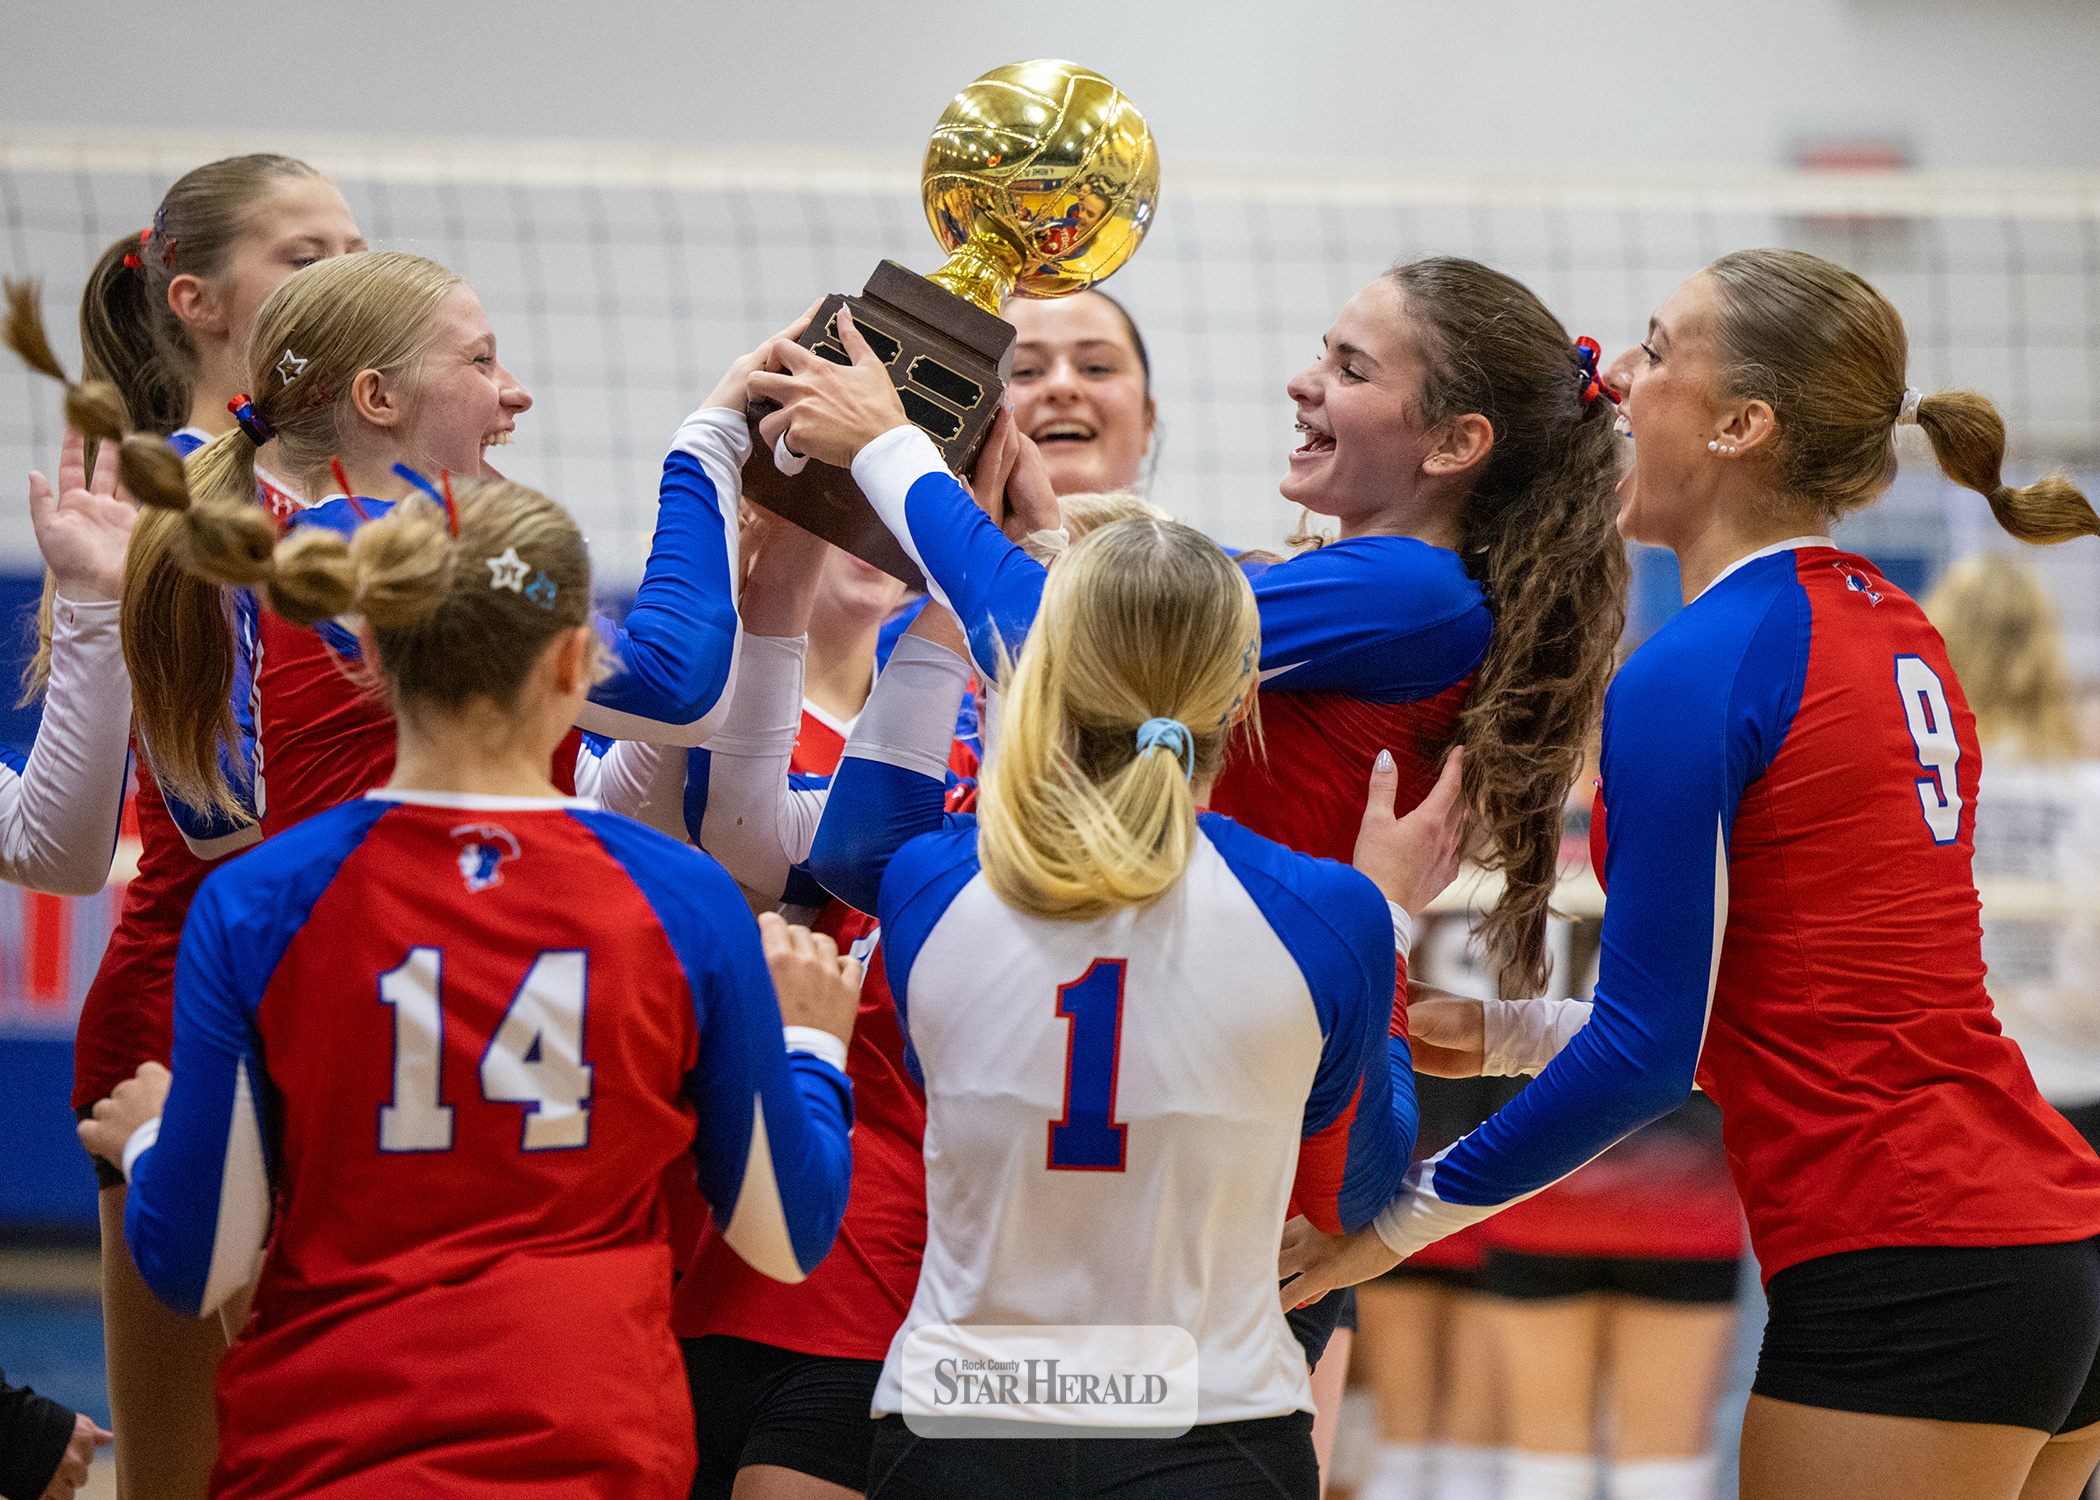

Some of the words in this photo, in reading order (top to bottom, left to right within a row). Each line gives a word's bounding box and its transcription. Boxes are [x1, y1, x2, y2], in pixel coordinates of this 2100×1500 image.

[1893, 653, 1964, 846] 9
[376, 944, 595, 1154] 14
[1046, 957, 1128, 1172] 1
